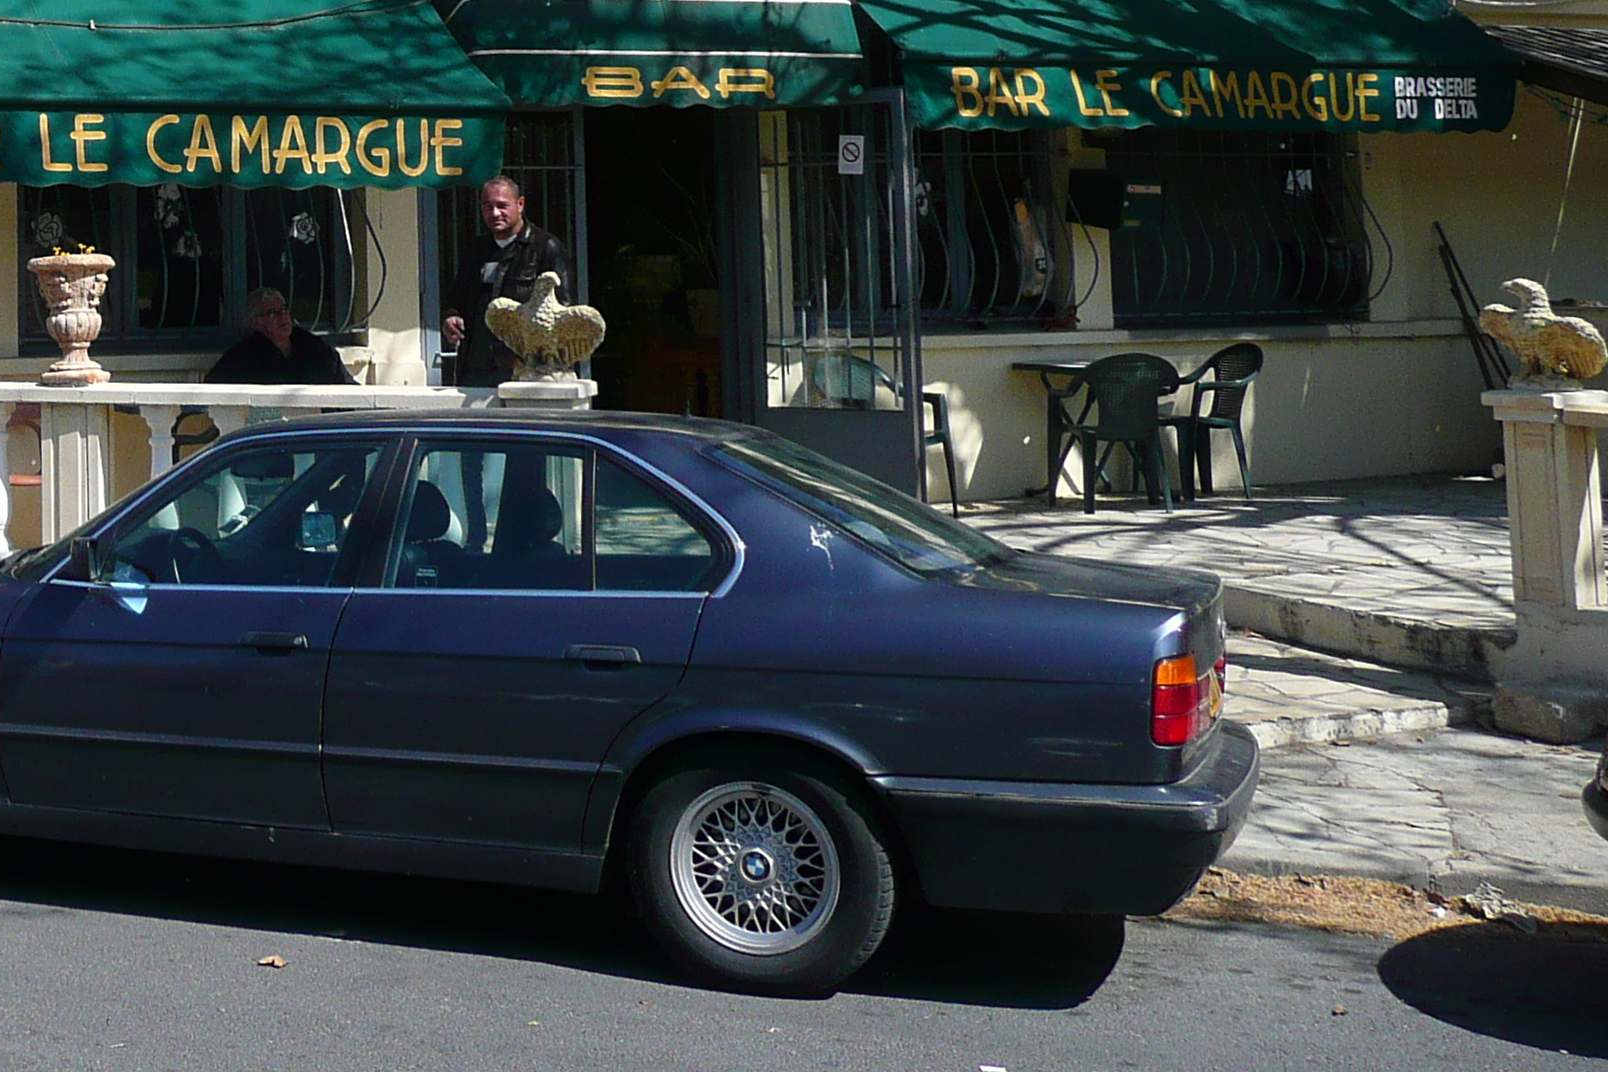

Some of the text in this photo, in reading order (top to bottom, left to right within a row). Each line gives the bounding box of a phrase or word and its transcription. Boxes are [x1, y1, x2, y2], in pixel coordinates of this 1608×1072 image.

[581, 66, 775, 100] BAR
[950, 66, 1381, 121] BAR LE CAMARGUE
[1394, 76, 1477, 98] BRASSERIE
[1395, 98, 1478, 120] DU DELTA
[39, 113, 108, 172] LE
[146, 114, 463, 177] CAMARGUE
